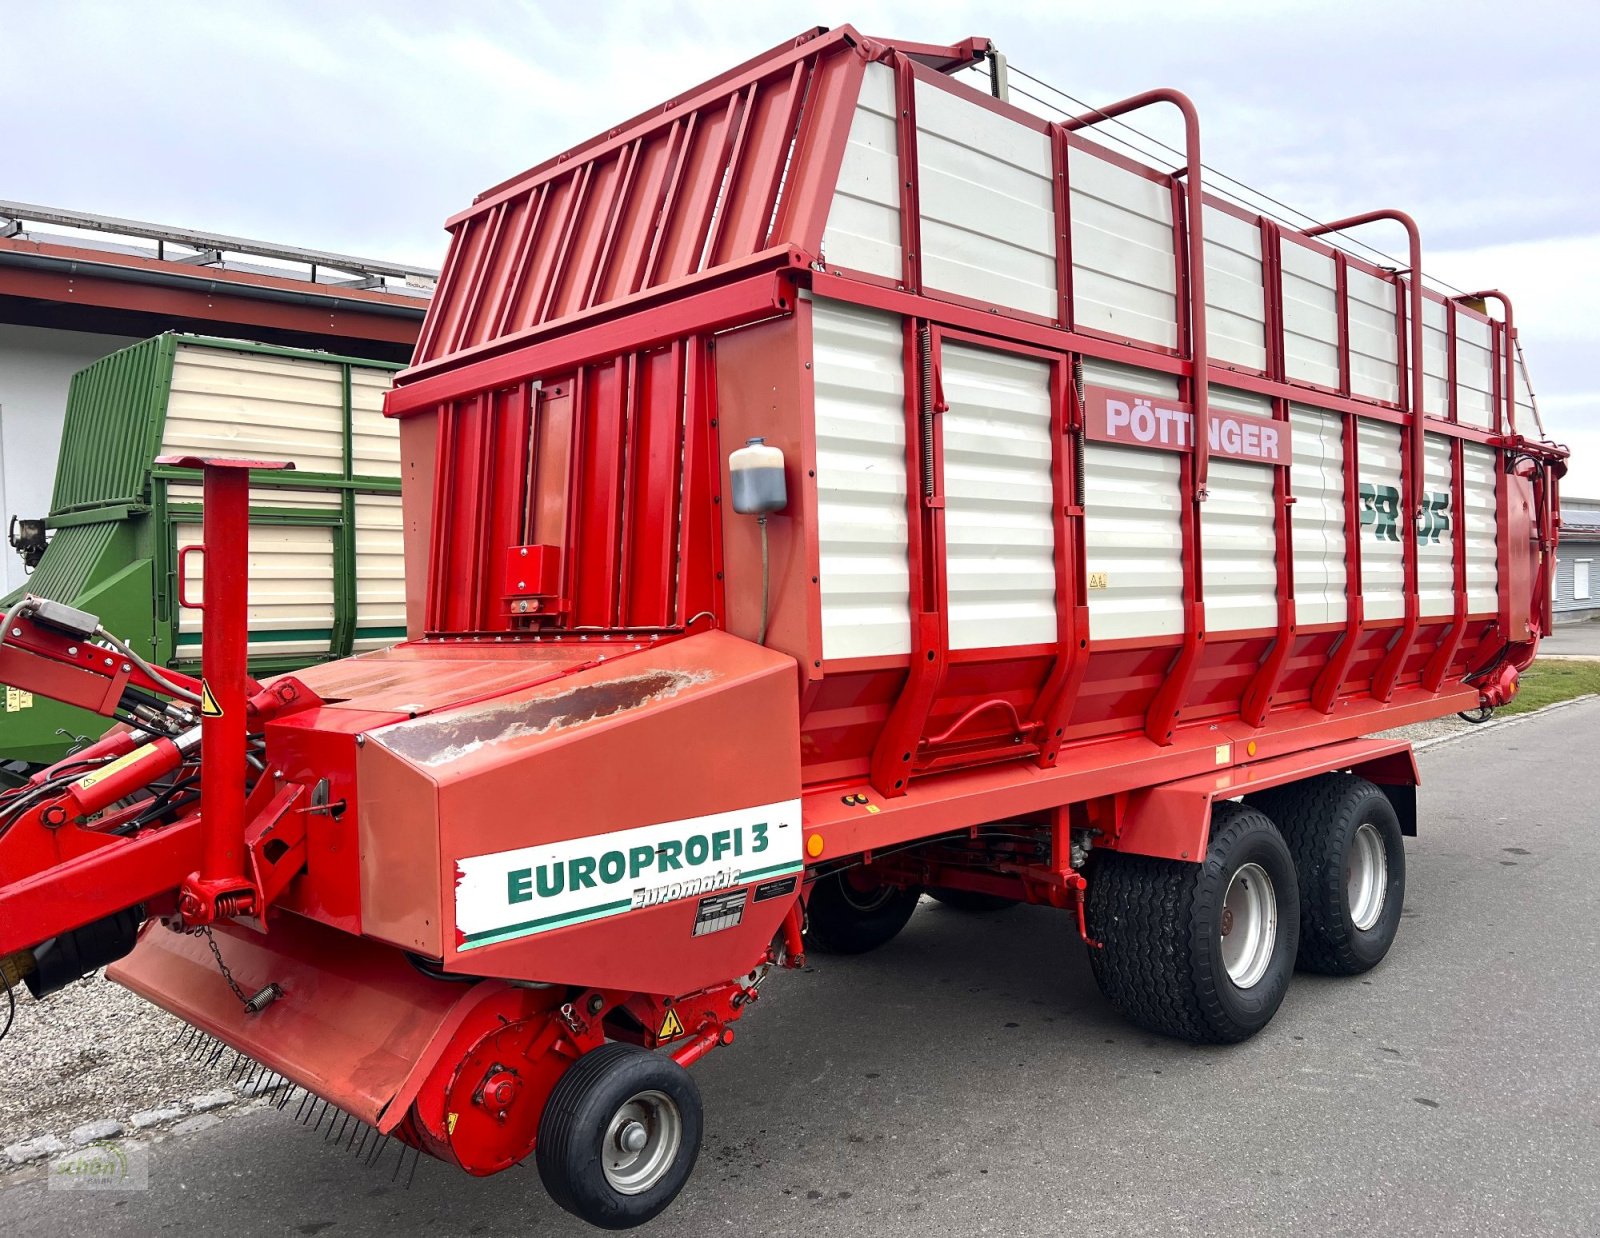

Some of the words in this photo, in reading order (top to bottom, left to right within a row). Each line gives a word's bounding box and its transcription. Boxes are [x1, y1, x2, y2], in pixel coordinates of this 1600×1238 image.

[507, 827, 743, 905] EUROPROFI
[751, 822, 770, 853] 3
[630, 867, 742, 910] Euromatic
